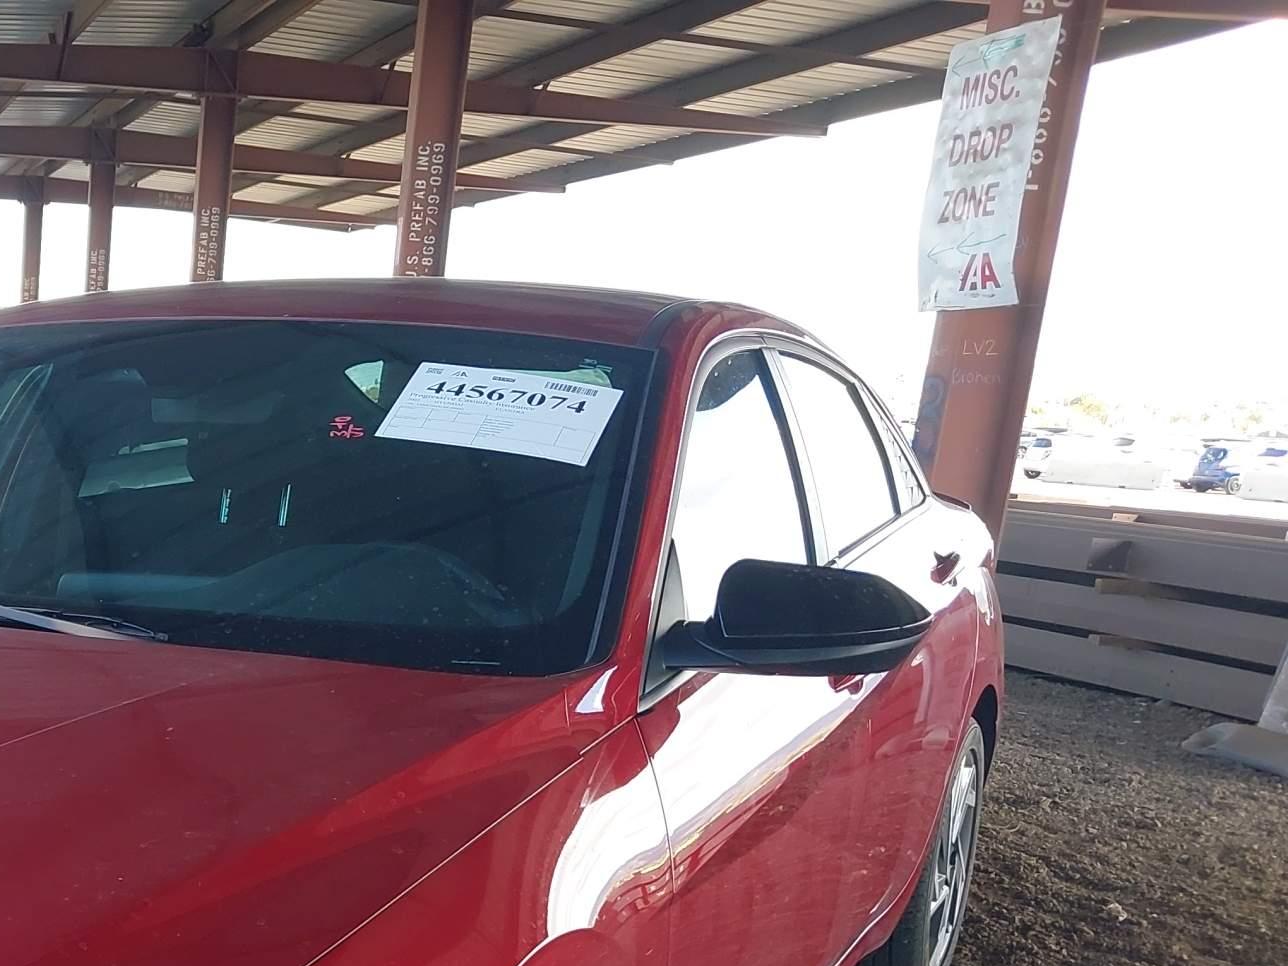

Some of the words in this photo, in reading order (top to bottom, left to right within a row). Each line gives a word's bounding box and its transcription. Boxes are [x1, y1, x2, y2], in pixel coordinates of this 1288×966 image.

[959, 65, 1020, 110] MISC.
[416, 141, 431, 171] INC.
[948, 123, 1013, 167] DROP
[408, 179, 426, 242] PREFAB
[937, 181, 1000, 224] ZONE
[196, 232, 209, 275] PREFAB
[426, 381, 588, 414] 44567074
